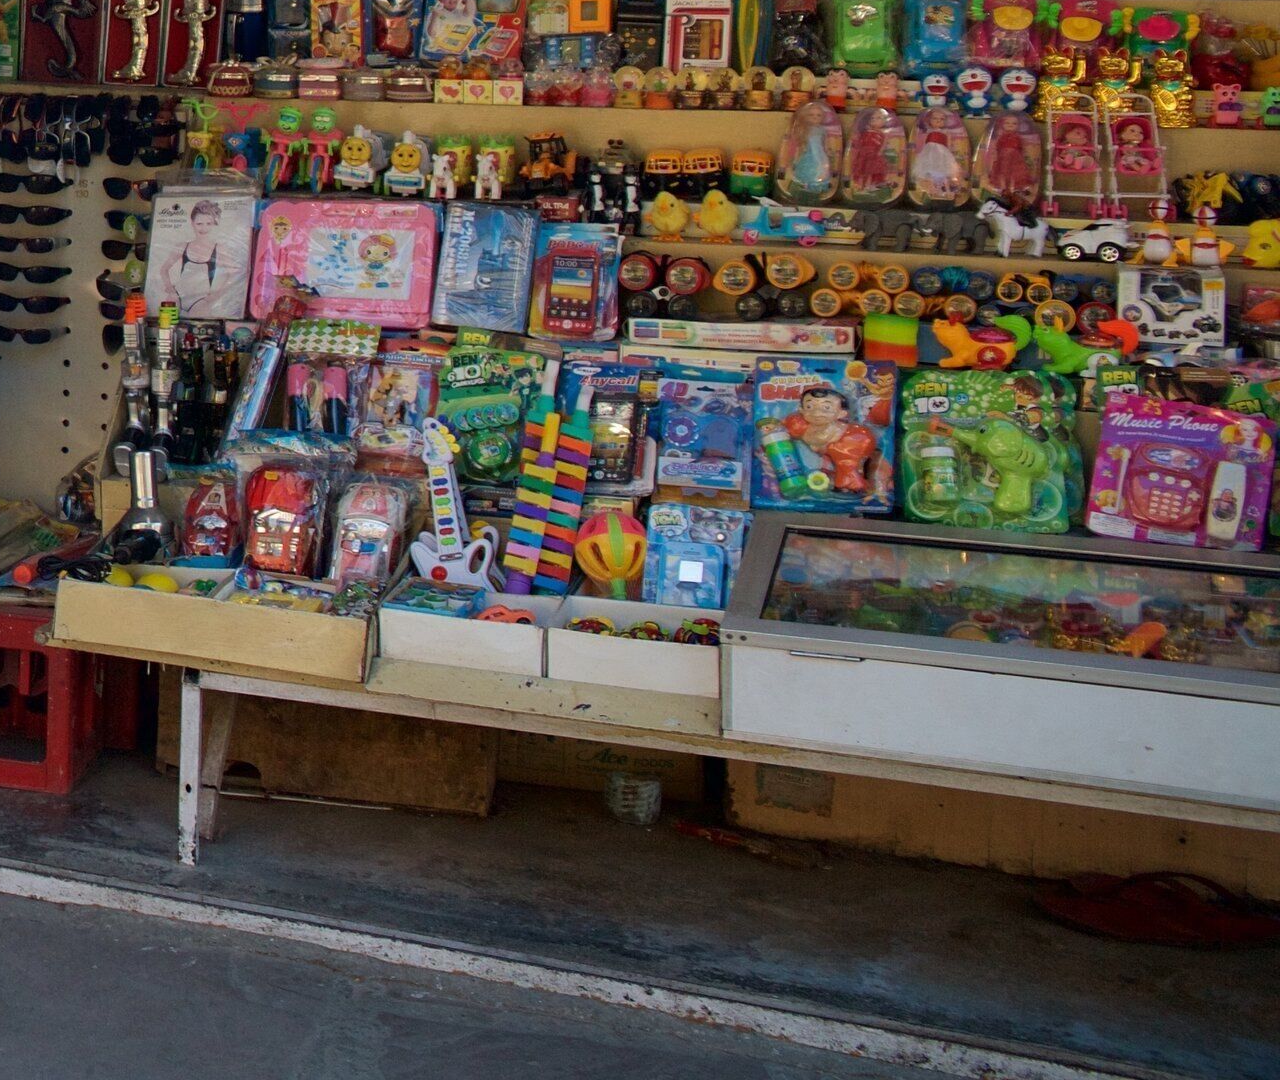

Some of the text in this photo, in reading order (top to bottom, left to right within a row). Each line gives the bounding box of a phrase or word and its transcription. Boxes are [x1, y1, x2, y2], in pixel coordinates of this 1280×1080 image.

[453, 354, 479, 367] BEN
[1101, 370, 1137, 385] BEN
[914, 382, 949, 398] BEN
[914, 396, 950, 414] 10
[1109, 411, 1220, 433] Music Phone
